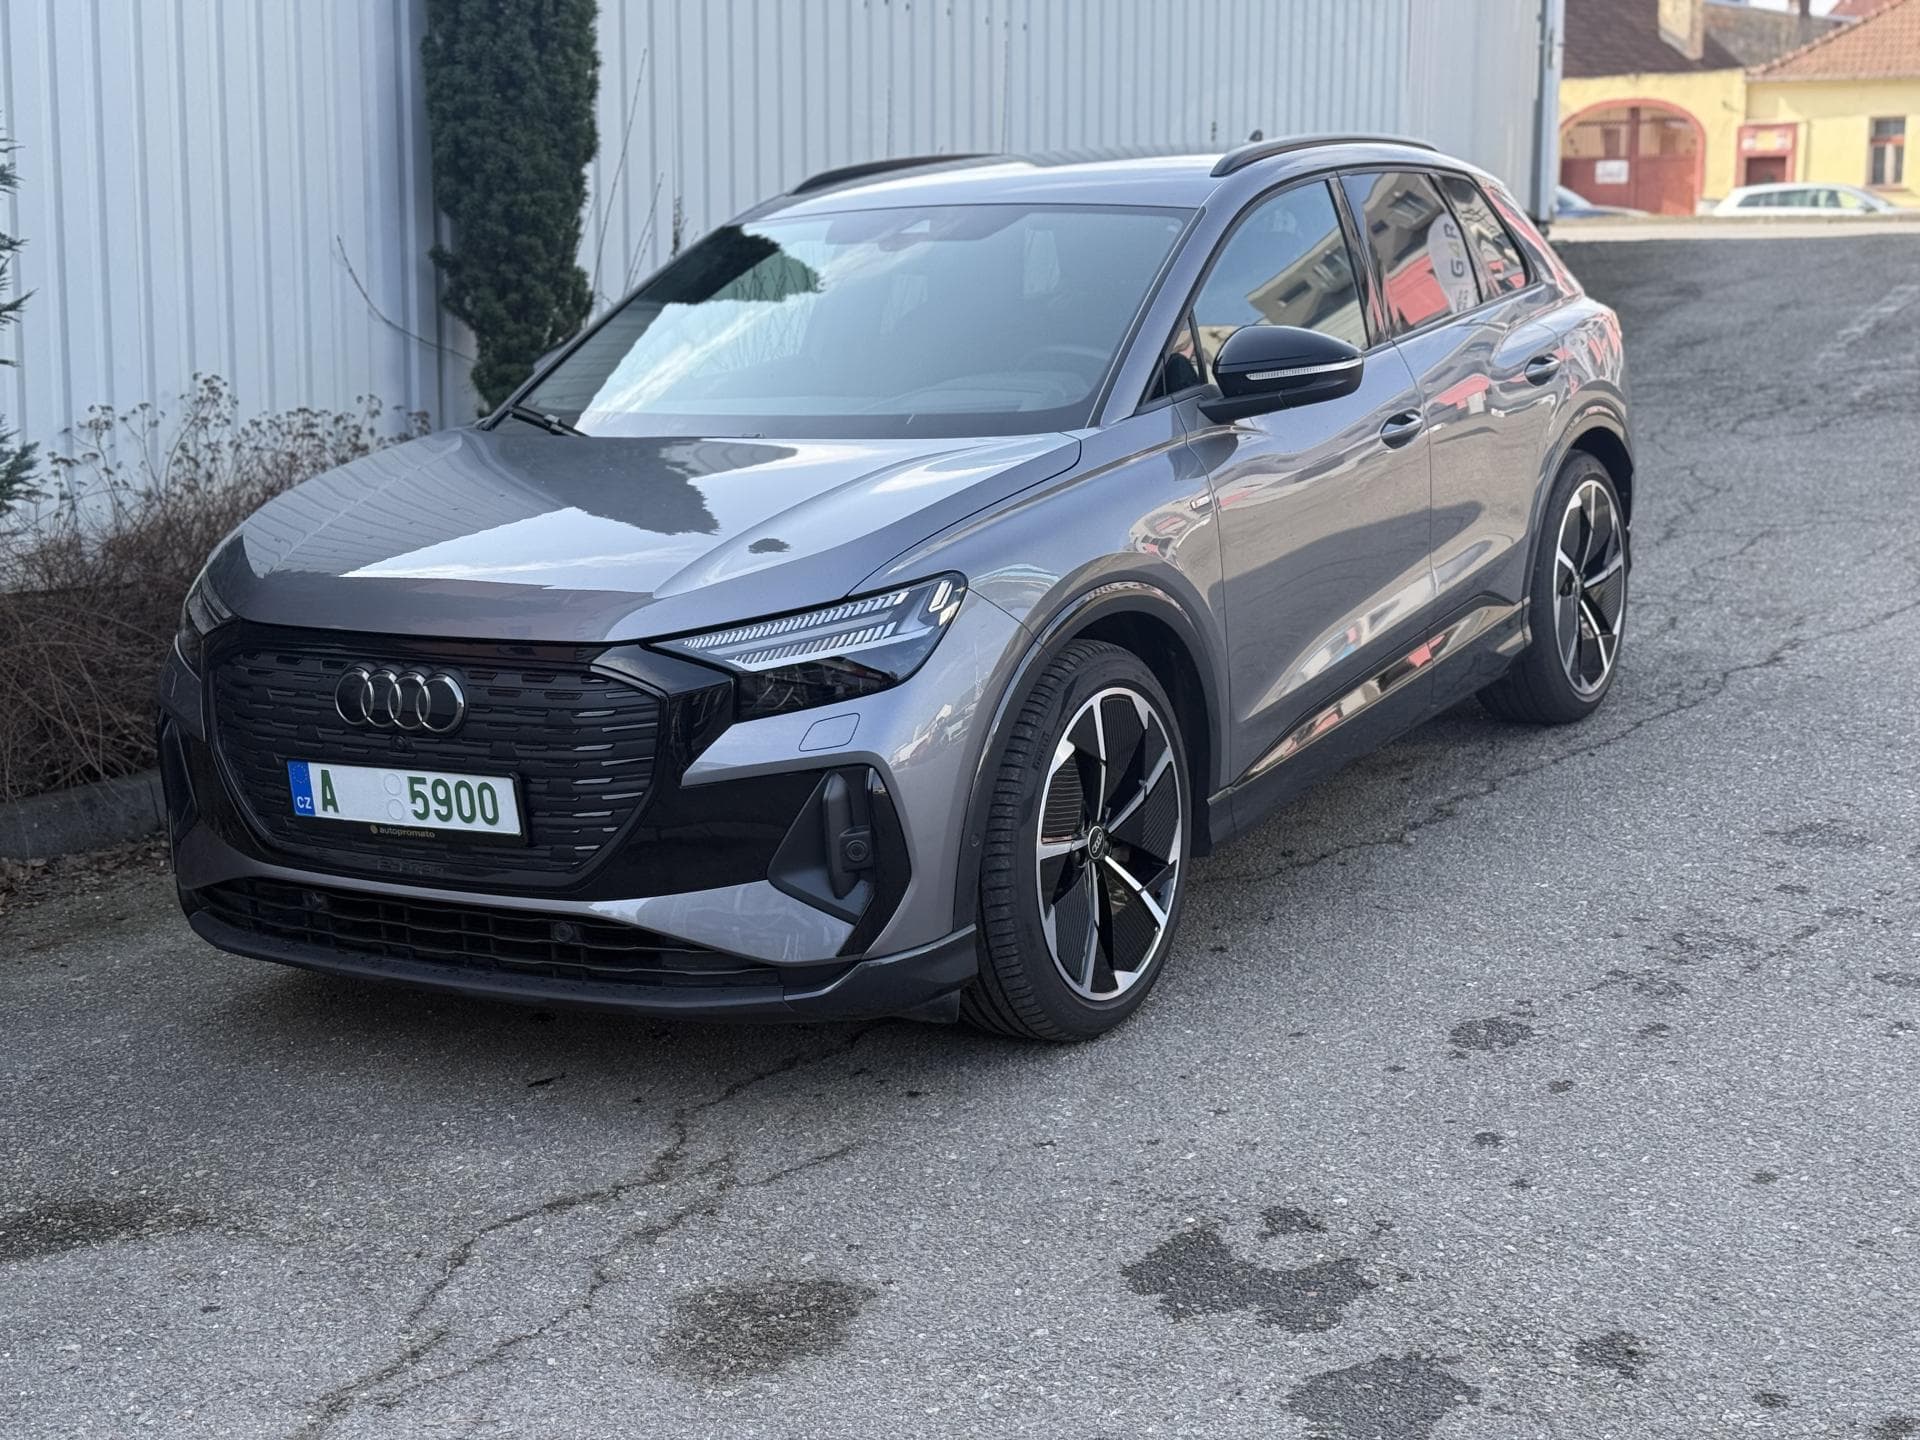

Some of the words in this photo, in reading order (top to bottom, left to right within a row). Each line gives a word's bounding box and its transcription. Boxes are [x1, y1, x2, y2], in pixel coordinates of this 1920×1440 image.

[296, 796, 312, 809] CZ
[320, 769, 340, 813] A
[407, 776, 499, 825] 5900
[379, 826, 436, 838] autopromato
